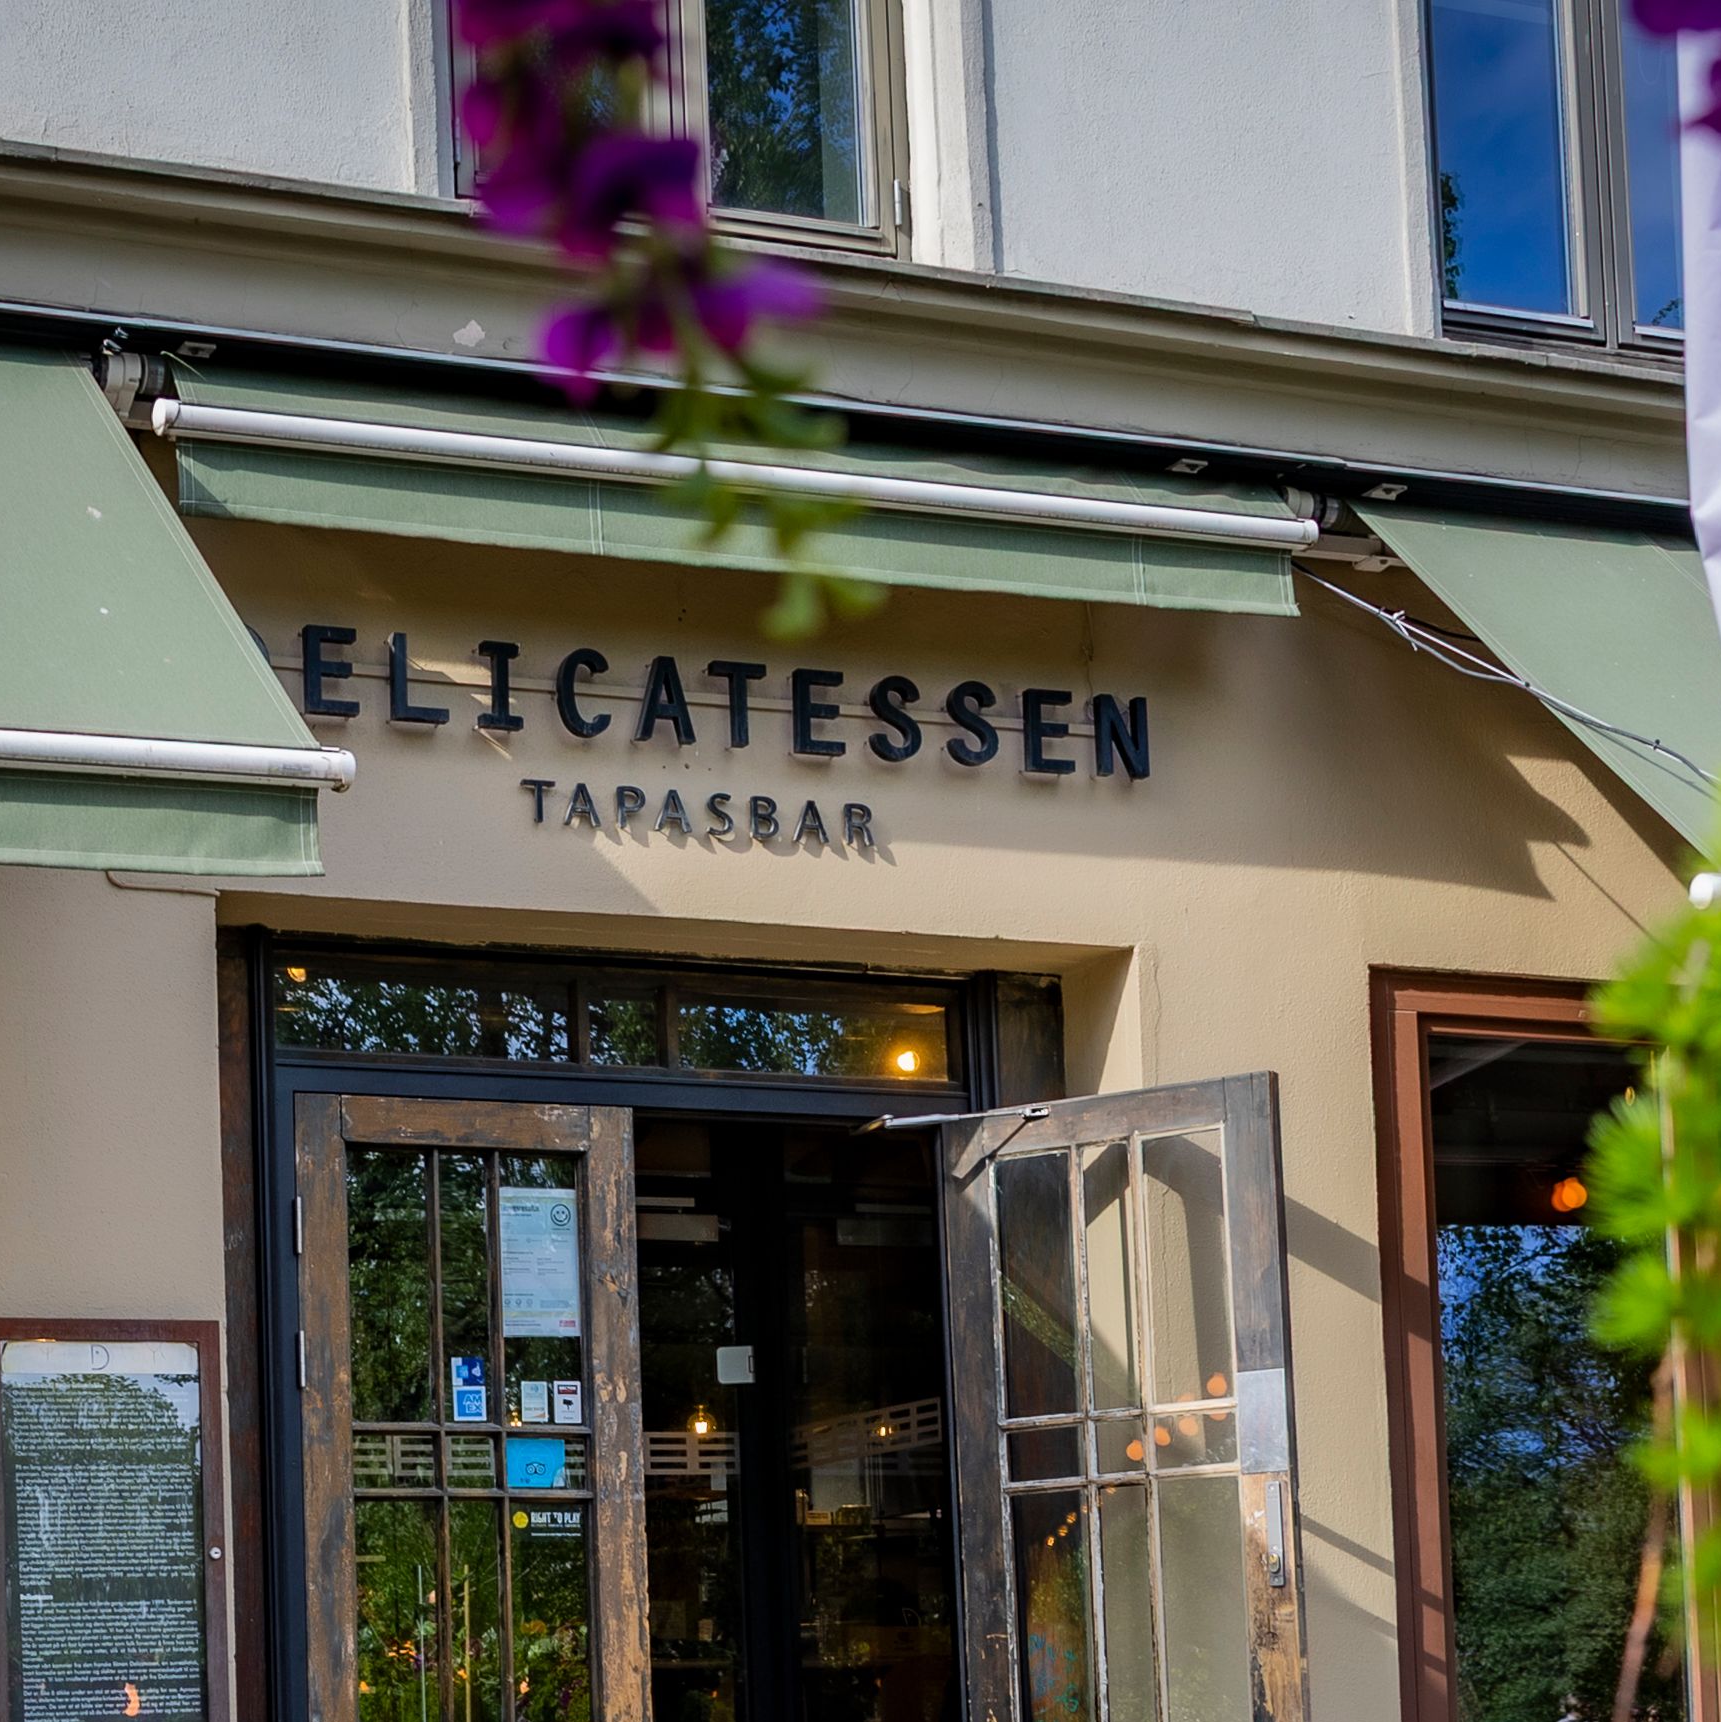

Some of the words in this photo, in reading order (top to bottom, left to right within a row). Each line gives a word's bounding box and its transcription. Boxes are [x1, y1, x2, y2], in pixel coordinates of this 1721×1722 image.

[244, 622, 1151, 781] ELICATESSEN
[519, 777, 875, 848] TAPASBAR
[530, 1511, 552, 1524] RIGHT
[564, 1511, 581, 1524] PLAY
